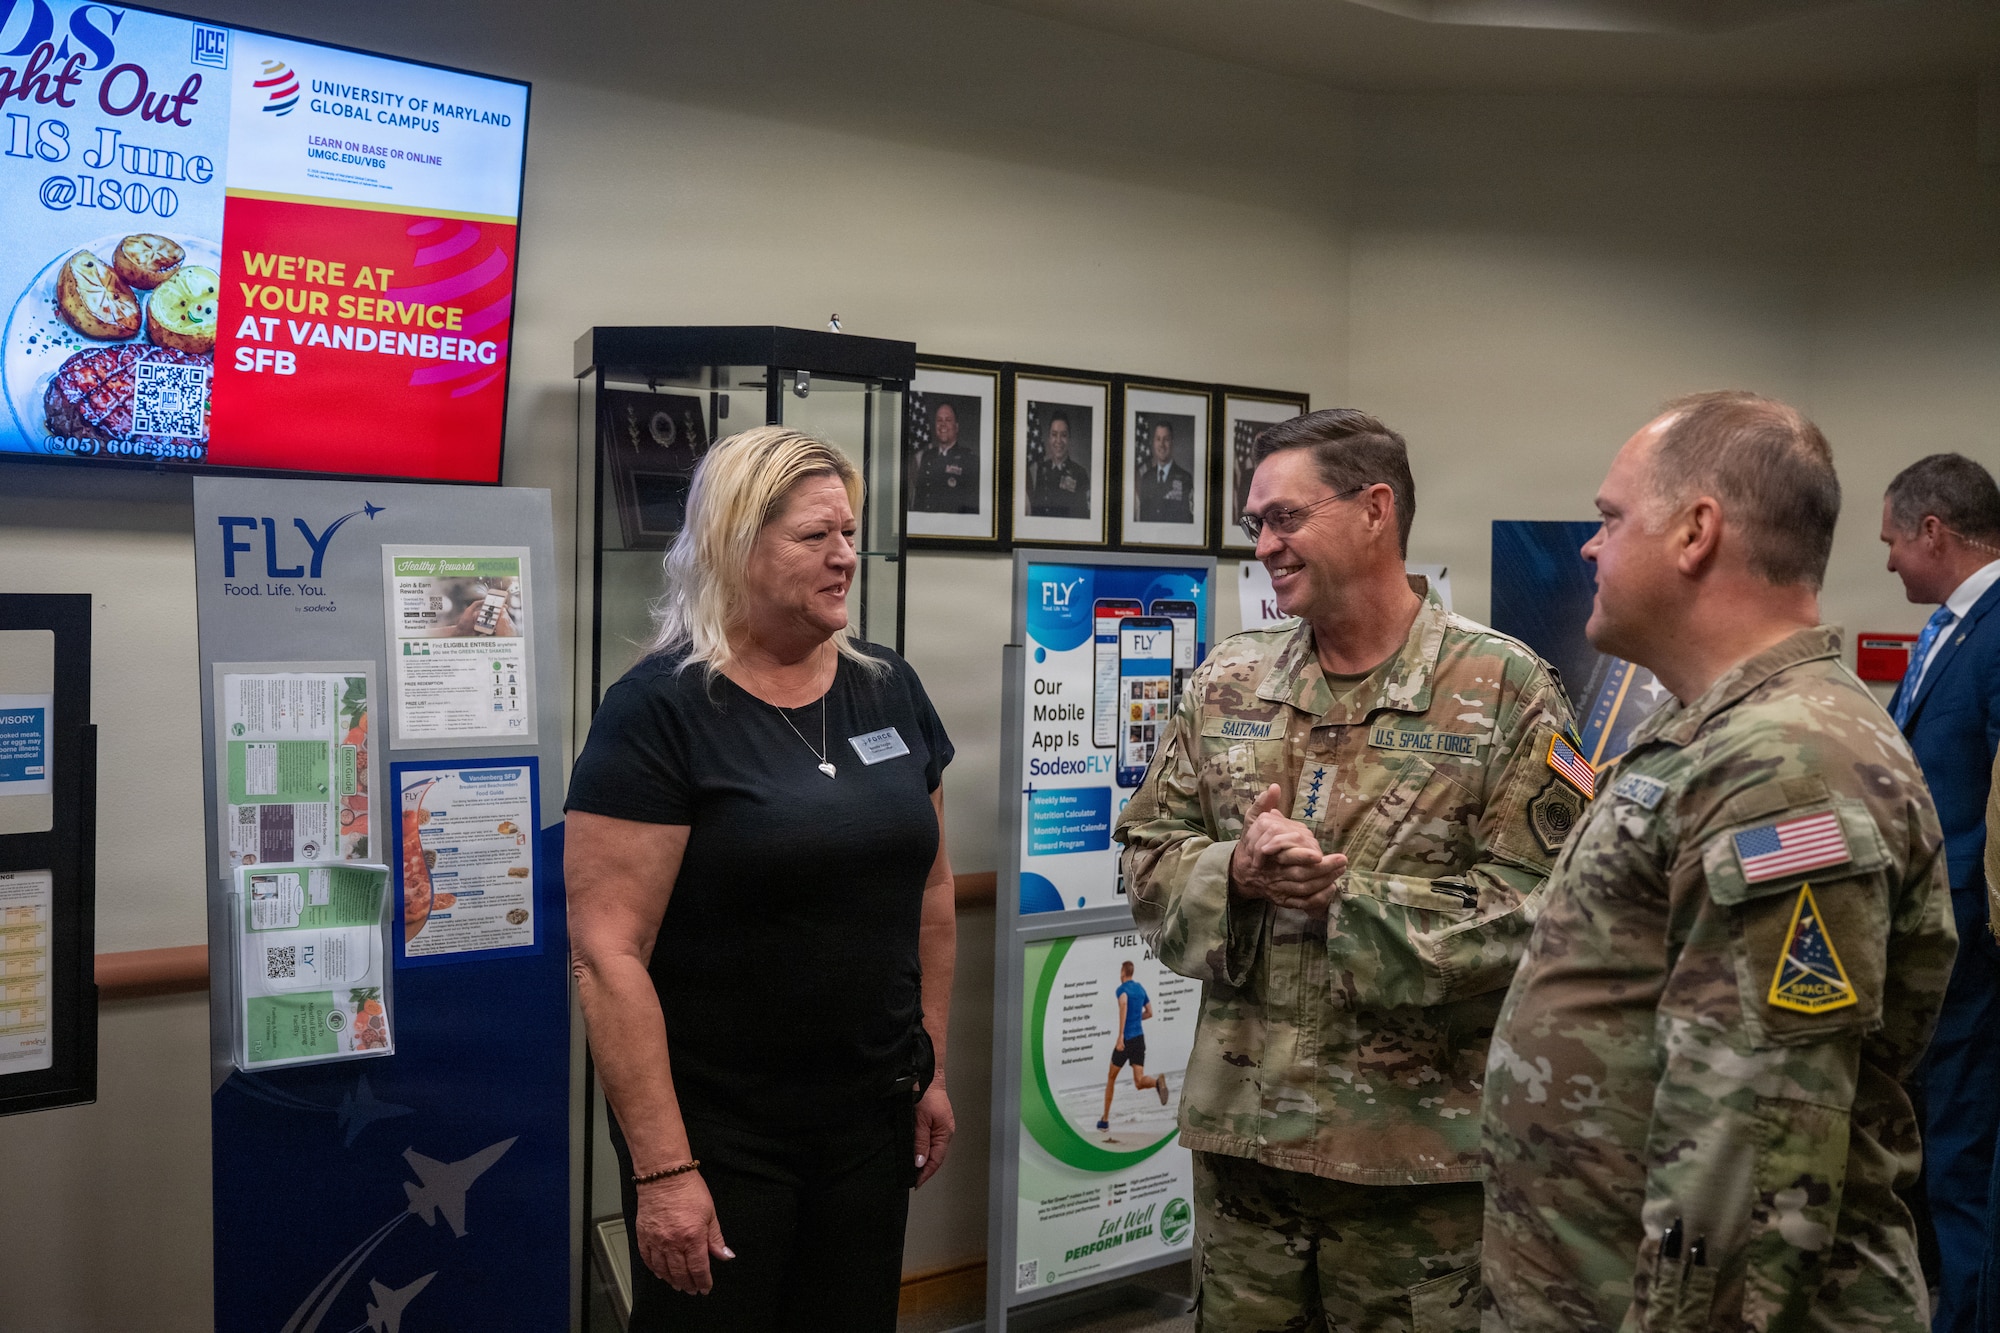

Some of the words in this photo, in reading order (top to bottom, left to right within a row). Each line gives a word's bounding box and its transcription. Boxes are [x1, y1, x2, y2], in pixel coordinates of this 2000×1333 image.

[98, 63, 203, 127] Out
[312, 79, 404, 108] UNIVERSITY
[408, 97, 429, 113] OF
[433, 102, 512, 127] MARYLAND
[310, 99, 373, 122] GLOBAL
[377, 110, 440, 134] CAMPUS
[5, 113, 71, 163] 18
[83, 127, 214, 184] June
[307, 148, 386, 169] UMGC.EDU/VBG
[308, 135, 343, 149] LEARN
[344, 141, 360, 153] ON
[361, 144, 389, 157] BASE
[390, 149, 404, 160] OR
[406, 151, 442, 166] ONLINE
[39, 175, 179, 218] @1800
[242, 250, 346, 286] WE’RE
[353, 266, 394, 292] AT
[239, 282, 329, 316] YOUR
[337, 294, 463, 331] SERVICE
[235, 315, 281, 342] AT
[287, 319, 498, 365] VANDENBERG
[234, 346, 297, 376] SFB
[44, 435, 100, 456] (805)
[106, 439, 203, 460] 606-3330
[218, 512, 346, 578] FLY
[398, 560, 436, 574] Healthy
[439, 560, 476, 574] Rewards
[224, 583, 263, 597] Food.
[267, 583, 295, 597] Life.
[299, 583, 327, 597] You.
[1042, 581, 1075, 606] FLY
[303, 601, 337, 613] sodexo
[1134, 634, 1158, 651] FLY
[1034, 678, 1063, 696] Our
[1033, 704, 1085, 722] Mobile
[1221, 721, 1271, 738] SALTZMAN
[1032, 731, 1063, 752] App
[1068, 732, 1079, 747] Is
[1375, 731, 1396, 747] U.S.
[1398, 732, 1434, 750] SPACE
[1436, 734, 1475, 755] FORCE
[345, 749, 353, 766] Icon
[1030, 754, 1113, 776] SodexoFLY
[345, 767, 353, 791] Guide
[468, 774, 504, 782] Vandenberg
[405, 792, 419, 801] FLY
[1034, 796, 1059, 805] Weekly
[1060, 796, 1077, 804] Menu
[1034, 811, 1064, 820] Nutrition
[1065, 809, 1096, 818] Calculator
[1034, 826, 1061, 836] Monthly
[1062, 826, 1080, 834] Event
[1081, 823, 1108, 832] Calendar
[1034, 841, 1058, 851] Reward
[1059, 841, 1085, 850] Program
[1113, 935, 1138, 949] FUEL
[304, 946, 314, 967] FLY
[1791, 983, 1832, 995] SPACE
[1098, 1216, 1123, 1239] Eat
[1123, 1202, 1156, 1230] Well
[1064, 1233, 1123, 1263] PERFORM
[1125, 1224, 1154, 1244] WELL
